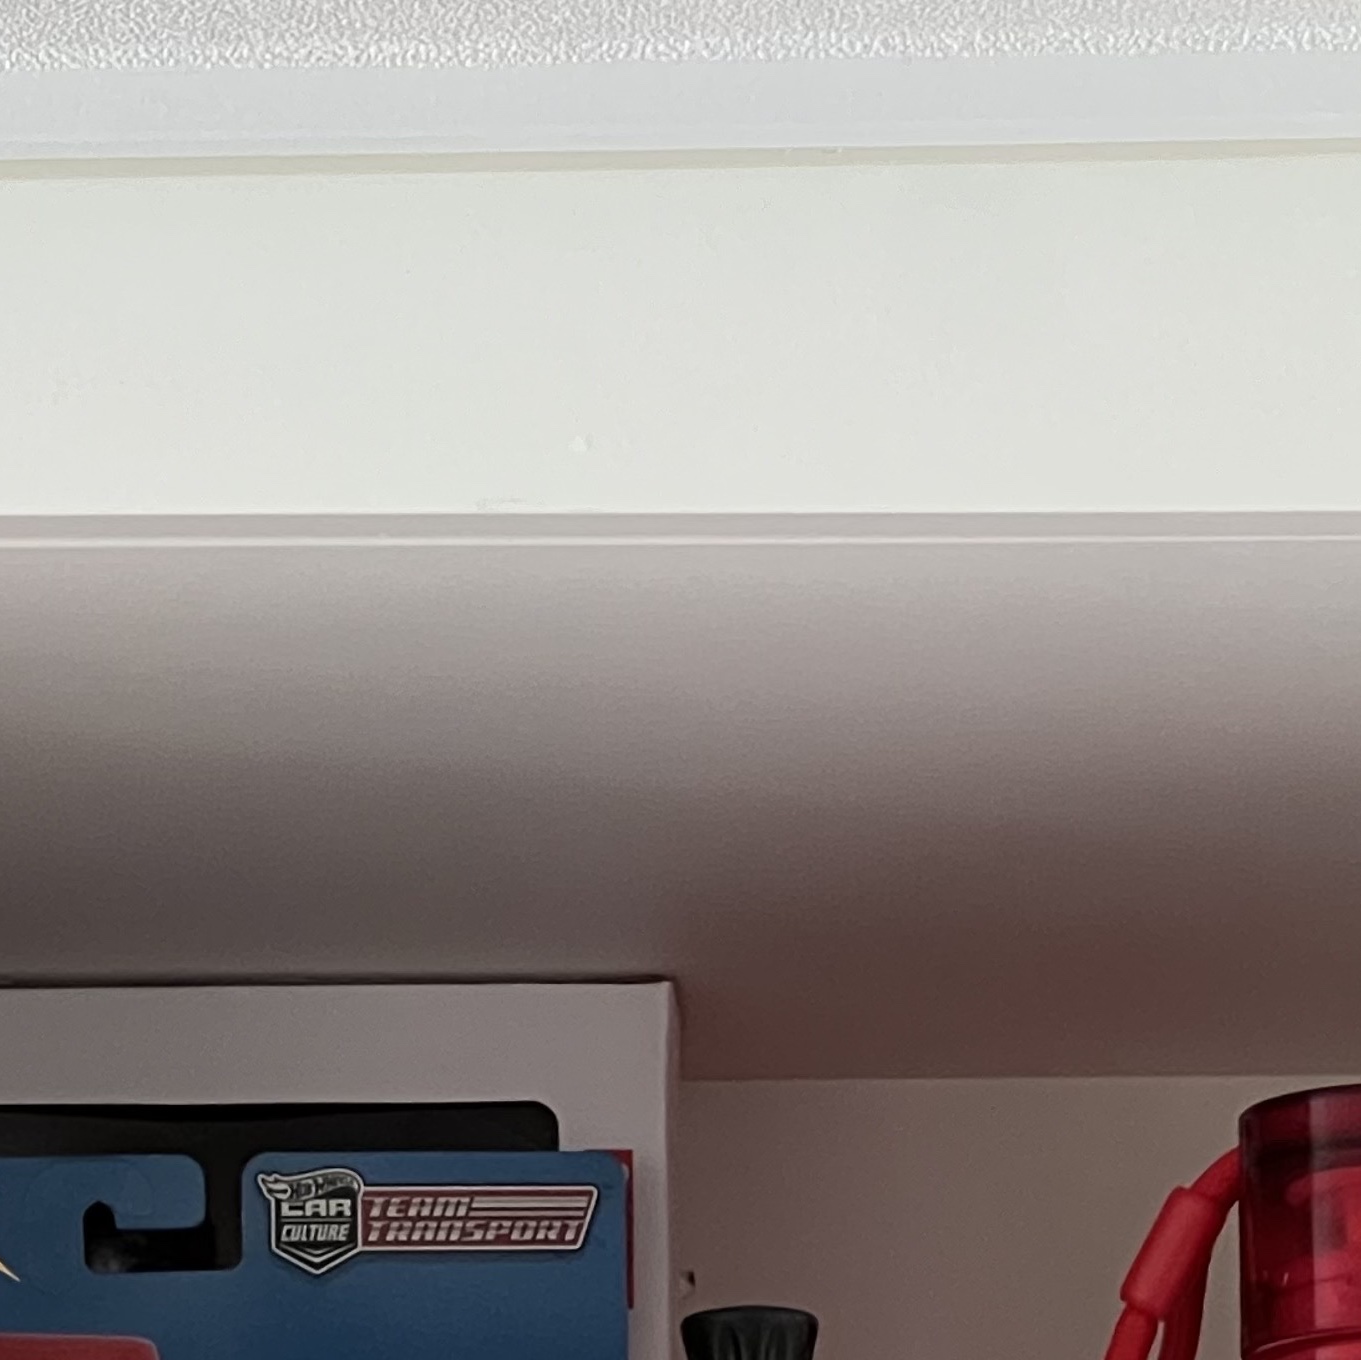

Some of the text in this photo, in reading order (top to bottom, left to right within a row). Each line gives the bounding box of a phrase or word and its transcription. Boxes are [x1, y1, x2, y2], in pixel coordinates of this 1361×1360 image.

[281, 1199, 352, 1217] CAR
[369, 1196, 472, 1218] TEAM
[281, 1223, 350, 1242] CULTURE
[368, 1220, 584, 1243] TRANSPORT
